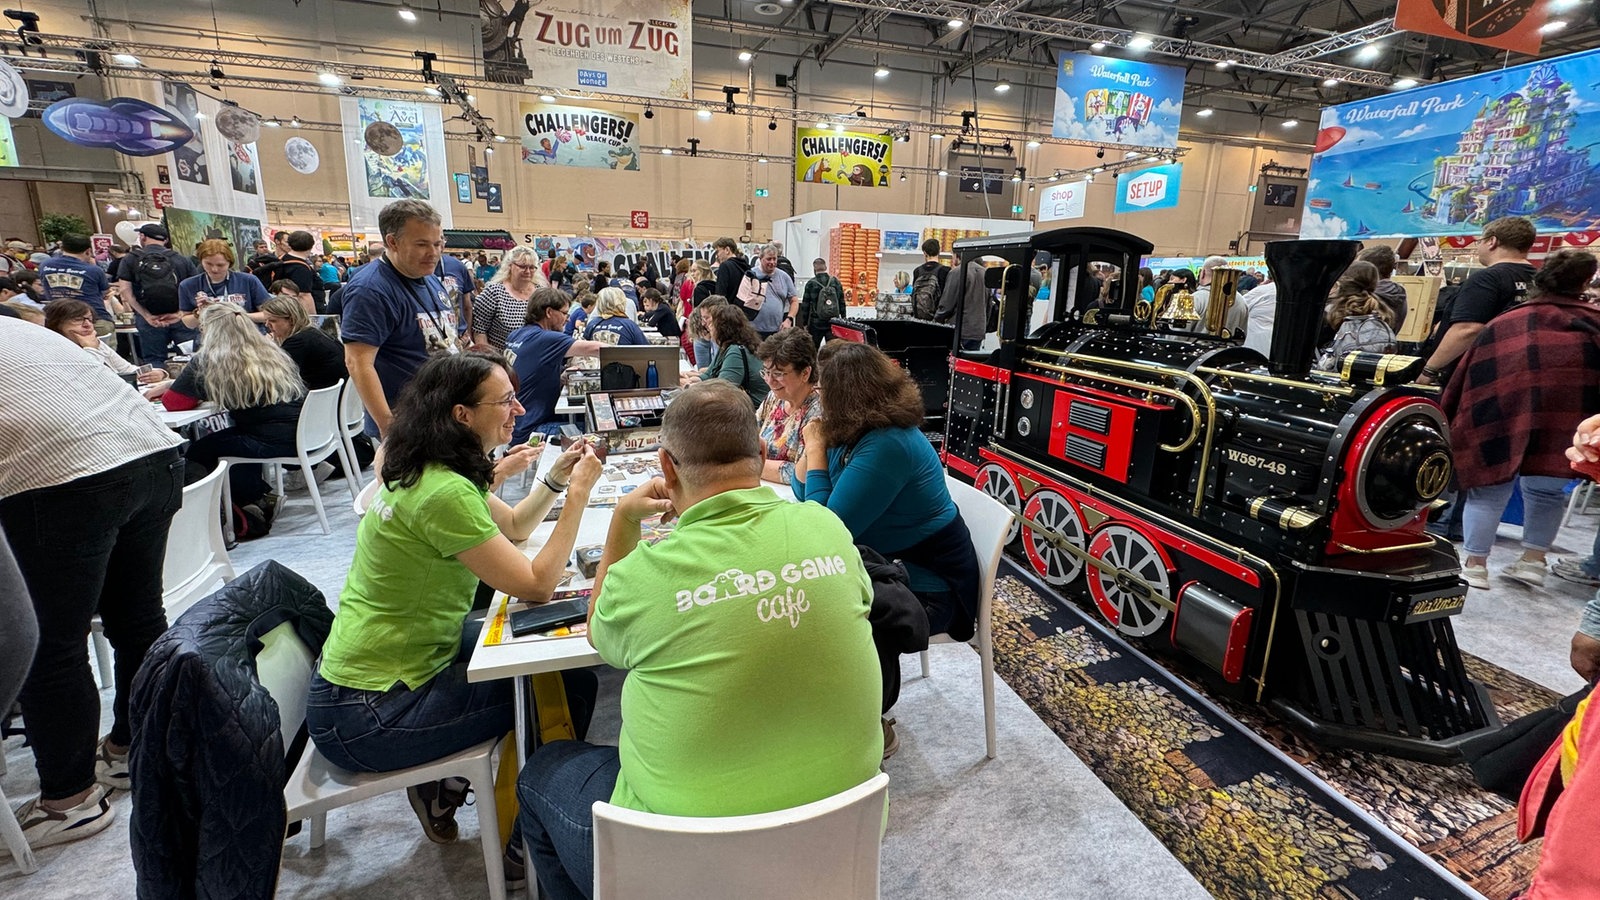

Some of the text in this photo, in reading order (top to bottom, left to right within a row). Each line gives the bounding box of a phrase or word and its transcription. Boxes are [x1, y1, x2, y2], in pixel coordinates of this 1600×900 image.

[535, 11, 590, 48] ZUG
[628, 21, 679, 57] ZUG
[1089, 64, 1155, 88] Waterfall Park
[390, 110, 418, 124] Avel
[1345, 93, 1470, 123] Waterfall Park
[525, 113, 635, 143] CHALLENGERS!
[585, 135, 622, 147] BEACH CUP
[802, 137, 888, 163] CHALLENGERS!
[1051, 190, 1073, 201] shop
[1130, 180, 1163, 200] SETUP
[1228, 448, 1287, 475] W587-48
[756, 586, 810, 629] cafe
